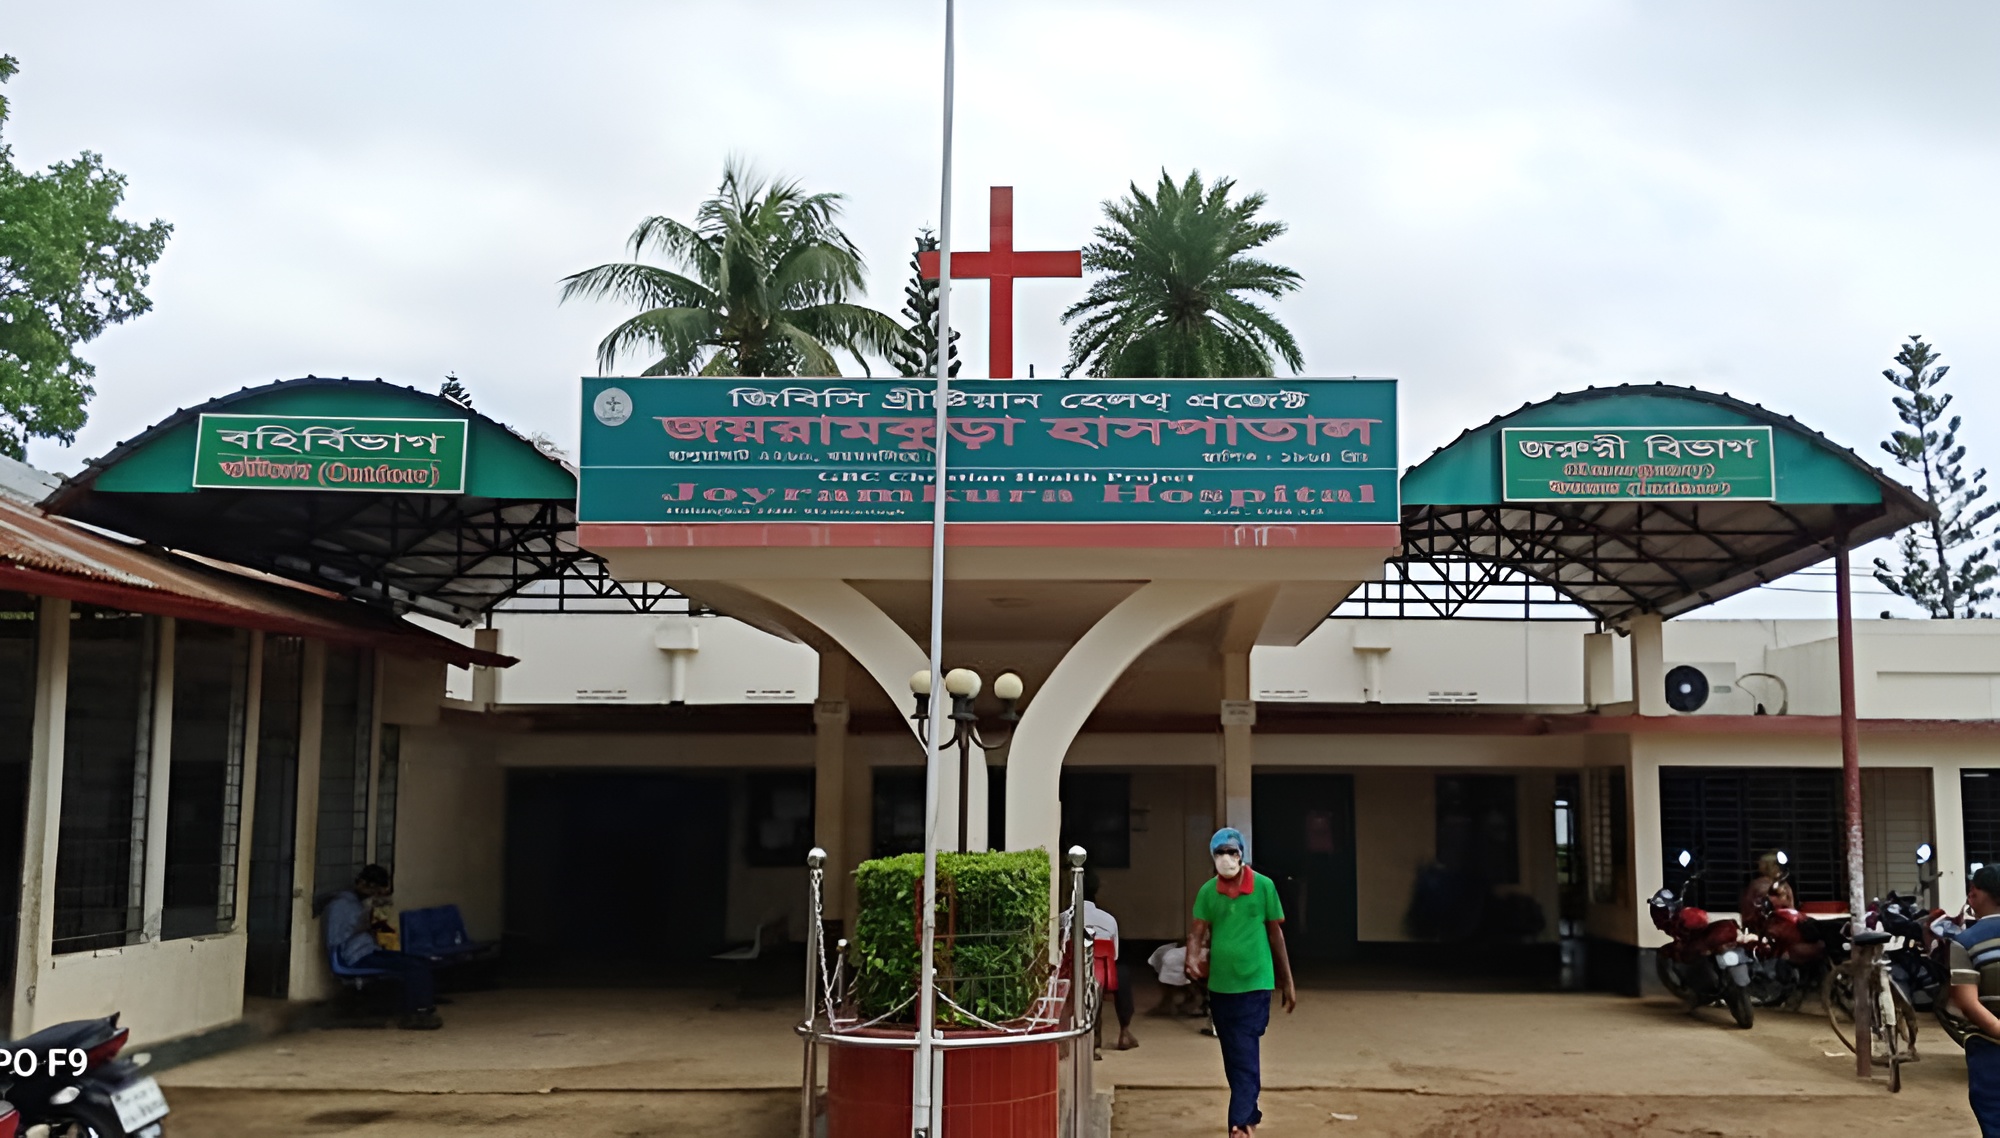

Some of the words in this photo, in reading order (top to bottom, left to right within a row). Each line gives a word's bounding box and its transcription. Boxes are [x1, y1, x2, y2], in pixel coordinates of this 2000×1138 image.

[727, 387, 870, 408] জিবিসি
[216, 424, 445, 455] বহির্বিভাগ
[1041, 414, 1382, 449] হাসপাতাল
[1643, 434, 1759, 460] বিভাগ
[1099, 484, 1376, 507] Hospital
